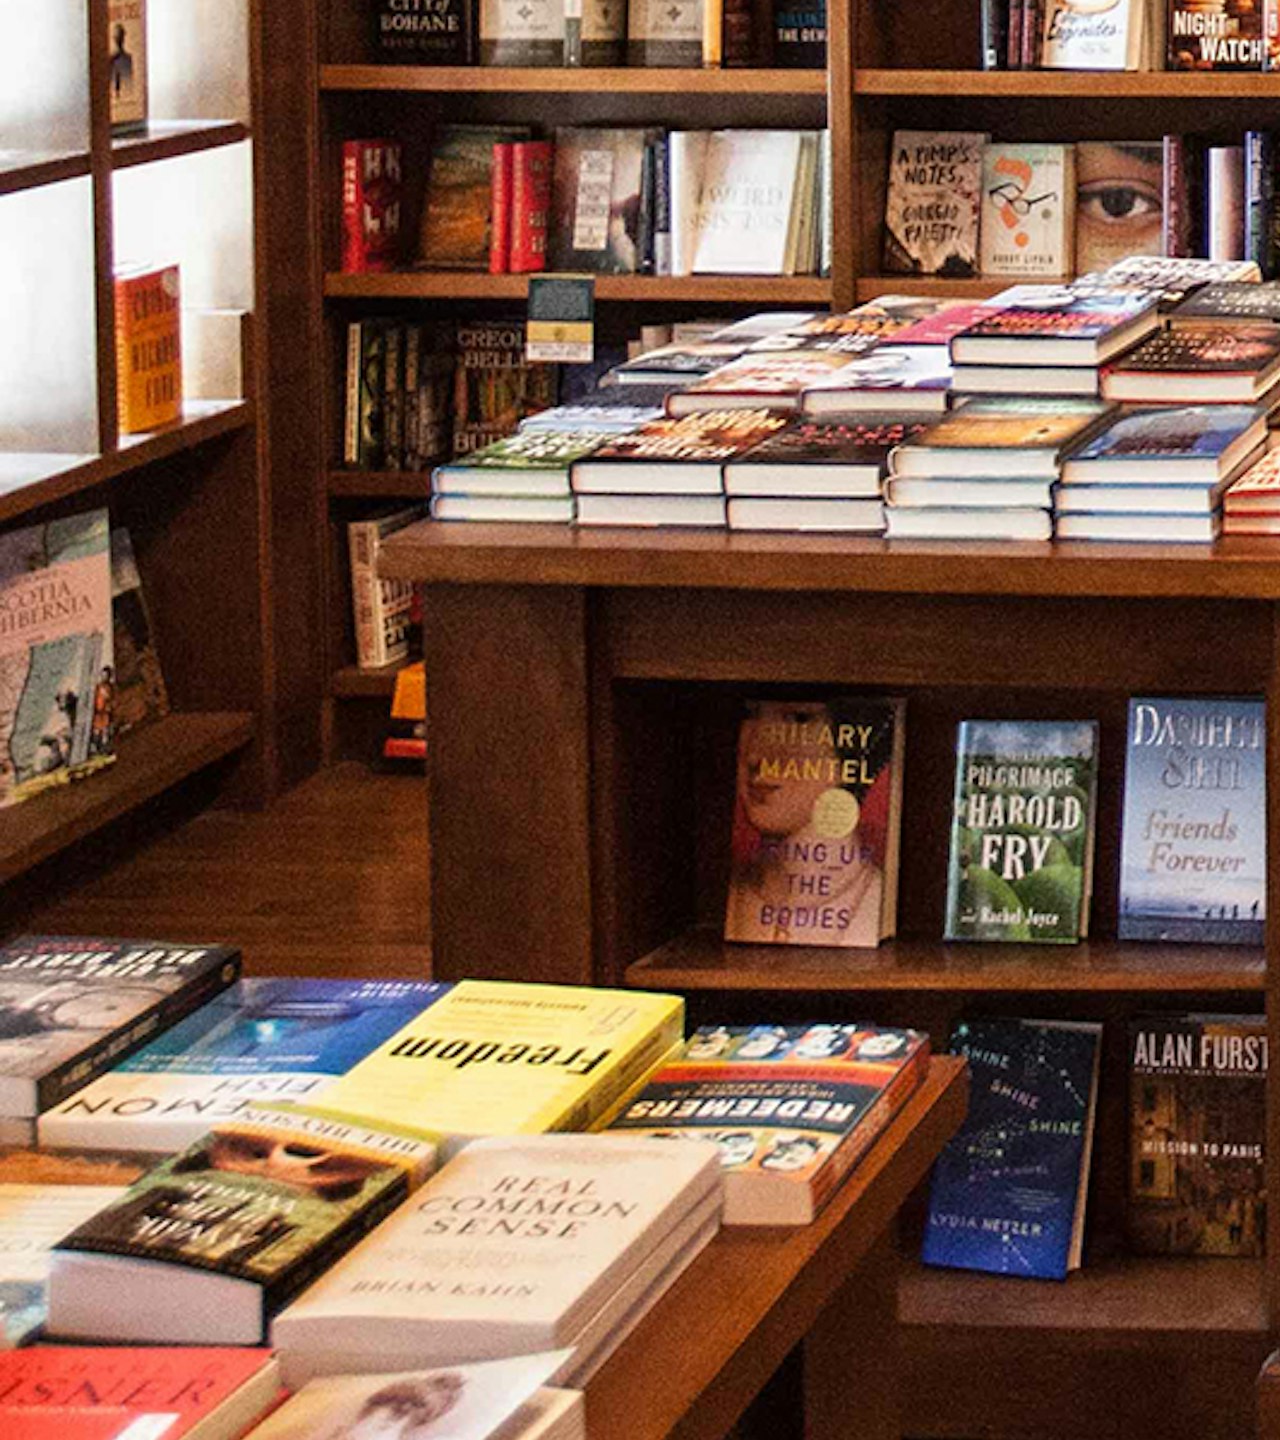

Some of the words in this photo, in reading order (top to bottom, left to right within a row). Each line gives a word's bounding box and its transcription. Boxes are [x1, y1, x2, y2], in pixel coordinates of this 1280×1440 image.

[381, 14, 459, 33] BOHANE
[1174, 11, 1226, 37] NIGHT
[1200, 39, 1262, 63] WATCH
[760, 724, 874, 748] HILARY
[758, 759, 875, 784] MANTEL
[966, 766, 1076, 788] PILGRIMAGE
[966, 794, 1080, 830] HAROLD
[1144, 809, 1238, 841] Friends
[980, 835, 1051, 880] FRY
[1146, 843, 1248, 875] Forever
[786, 876, 832, 896] THE
[760, 905, 851, 930] BODIES
[980, 907, 1022, 925] Rachel
[1025, 908, 1059, 927] Joyce
[389, 1035, 611, 1076] Freedom
[961, 1042, 1011, 1069] SHINE
[1133, 1032, 1193, 1065] ALAN
[212, 1077, 327, 1095] FISH
[989, 1079, 1040, 1109] SHINE
[625, 1099, 857, 1121] REDEEMERS
[239, 1110, 347, 1141] BRYSON
[1028, 1119, 1082, 1136] SHINE
[358, 1131, 421, 1154] BILL
[1142, 1142, 1198, 1158] MISSION
[1203, 1144, 1218, 1158] TO
[1221, 1144, 1262, 1159] PARIS
[492, 1176, 598, 1196] REAL
[418, 1198, 639, 1218] COMMON
[424, 1218, 586, 1239] SENSE
[931, 1213, 977, 1231] LYDIA
[981, 1219, 1042, 1236] NETZER
[349, 1279, 440, 1296] BRIAN
[450, 1283, 538, 1297] KAHN
